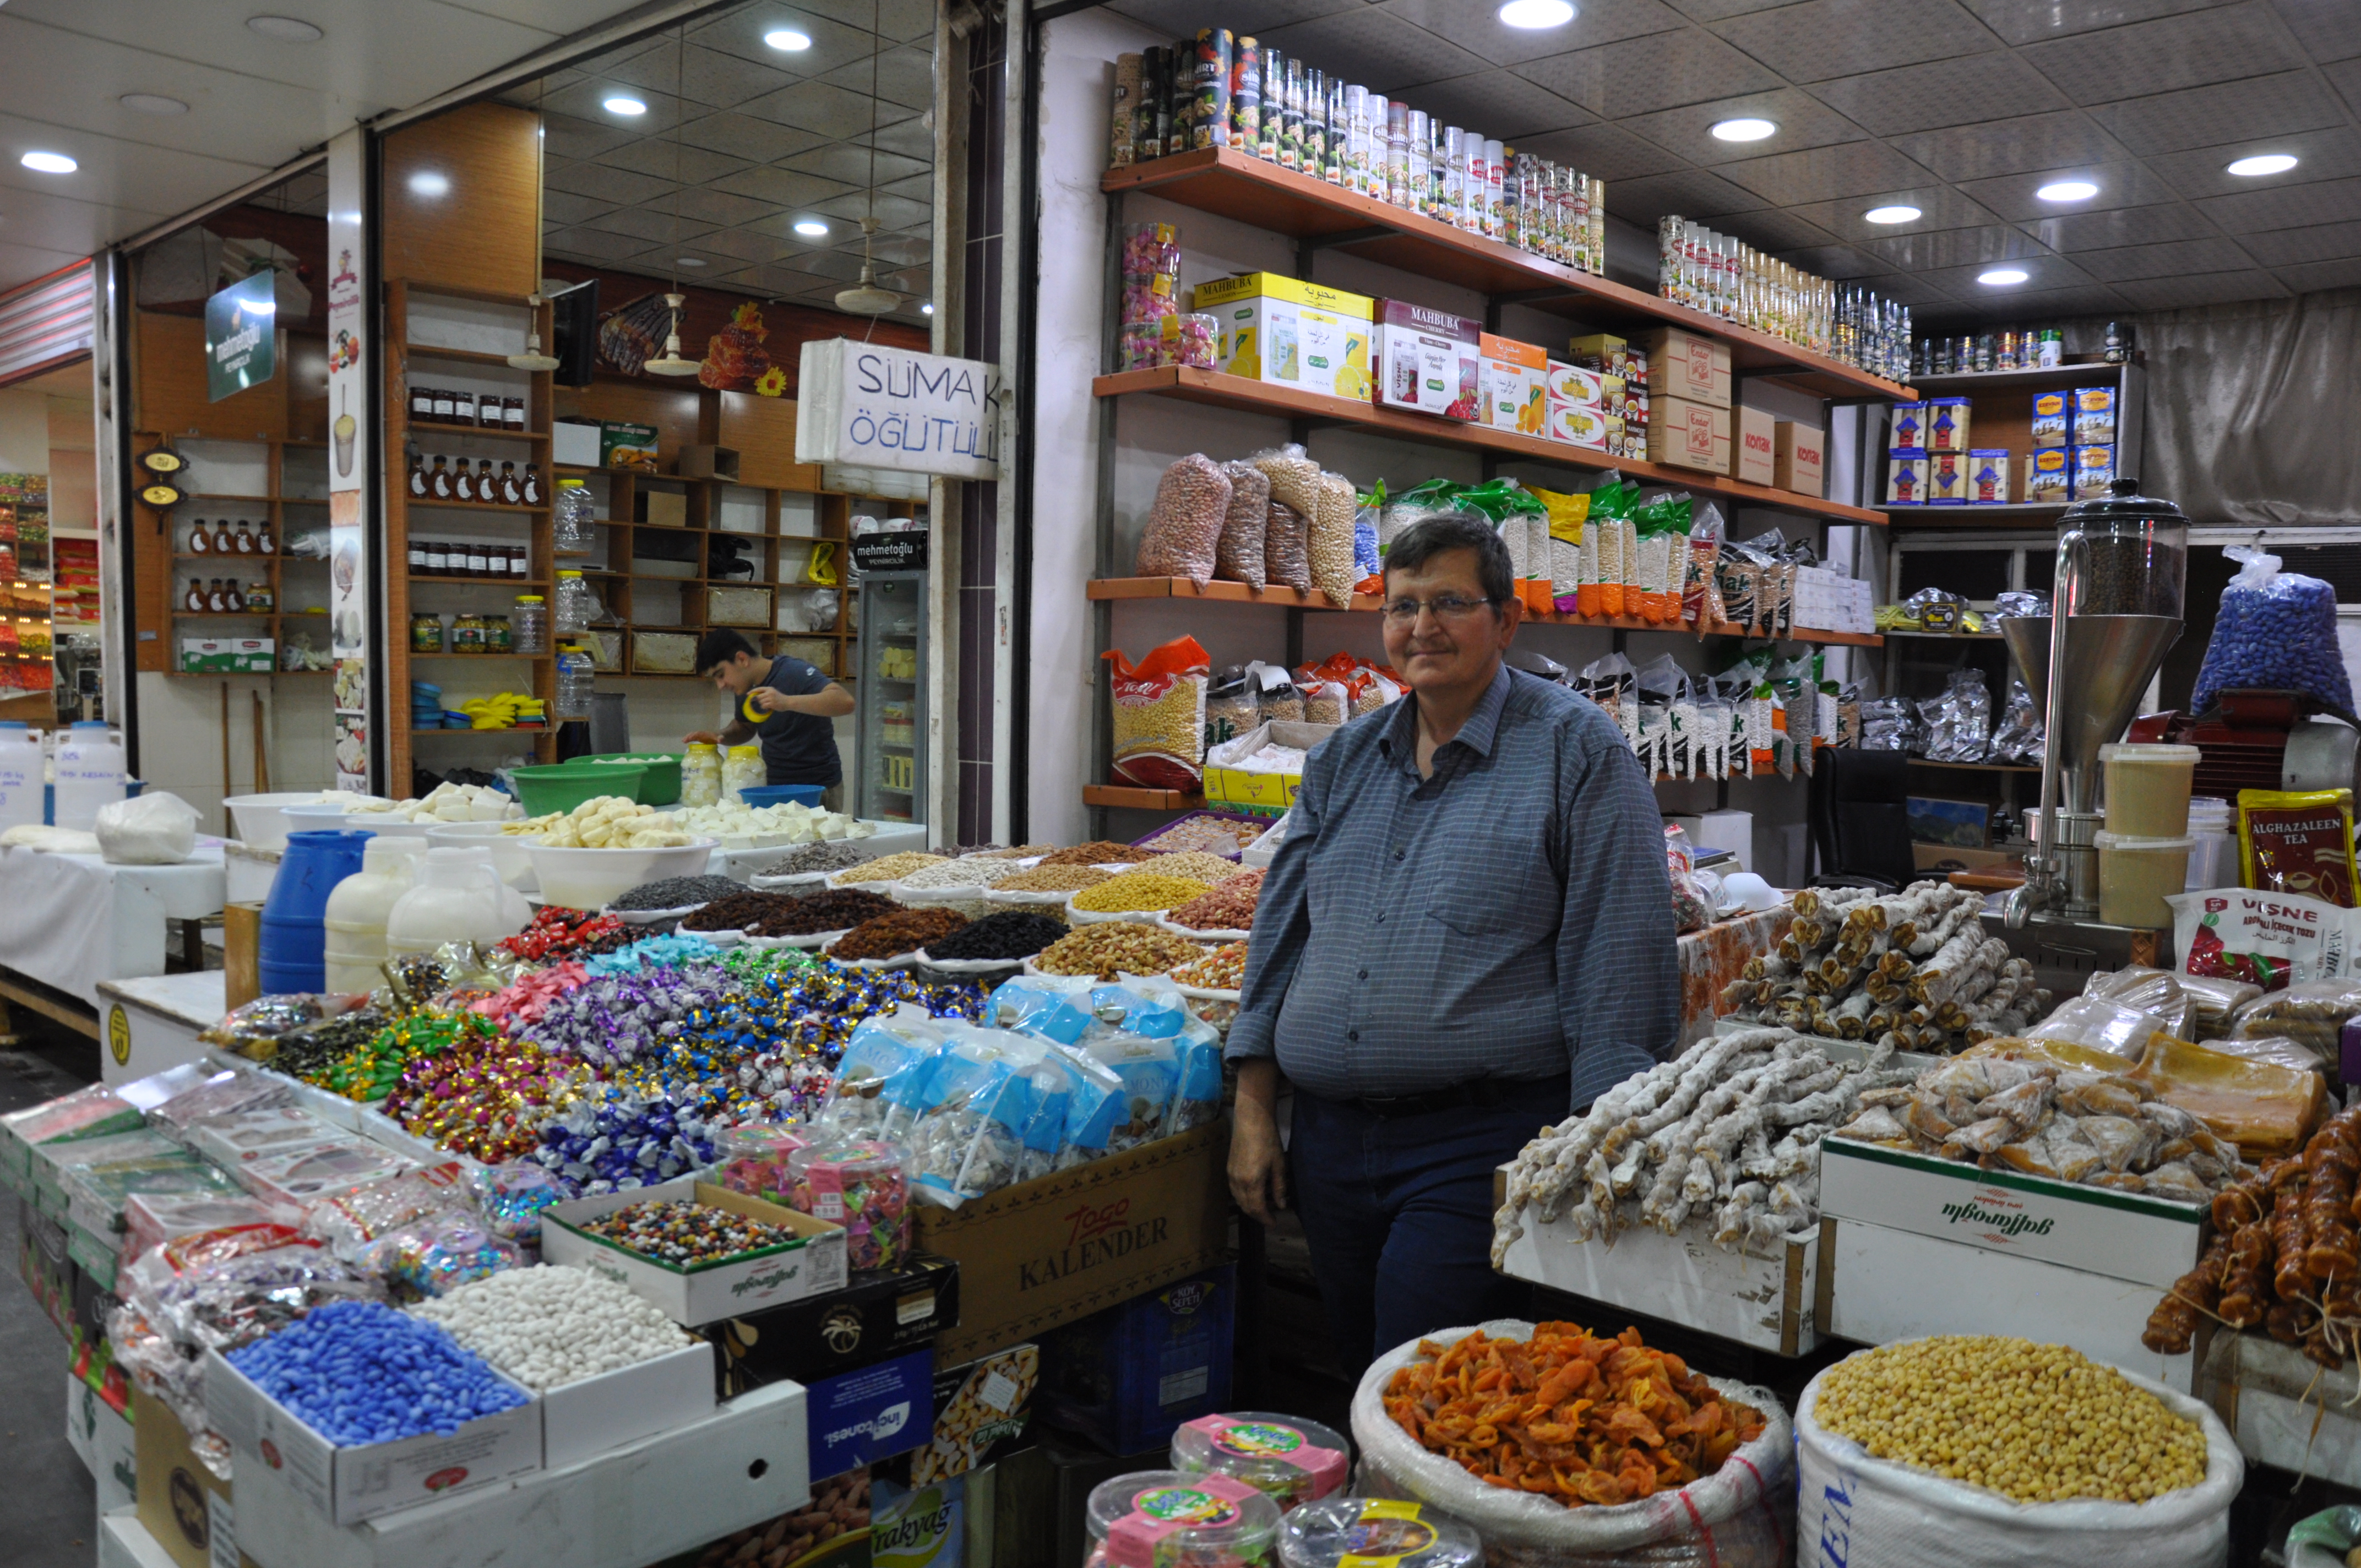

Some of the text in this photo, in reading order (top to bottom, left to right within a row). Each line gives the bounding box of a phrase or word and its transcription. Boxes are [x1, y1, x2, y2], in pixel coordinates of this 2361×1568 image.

[1204, 277, 1252, 296] MAHBUBA
[1304, 282, 1336, 300] محبوبة
[1218, 291, 1237, 300] LEMON
[1411, 307, 1459, 330] MAHBUBA
[1425, 325, 1445, 334] CHERRY
[858, 354, 1000, 413] SÜMAK
[857, 541, 913, 557] mehmetoğlu
[868, 557, 906, 566] PEYNİRCİLİK
[2253, 819, 2341, 834] ALGHAZALEEN
[2283, 834, 2308, 845] TEA
[2296, 927, 2316, 939] TOZU
[1941, 1203, 2055, 1237] gaffaroğlu
[1018, 1216, 1168, 1292] KALENDER
[1177, 1284, 1196, 1298] KÖY
[1172, 1292, 1201, 1309] SEPETİ
